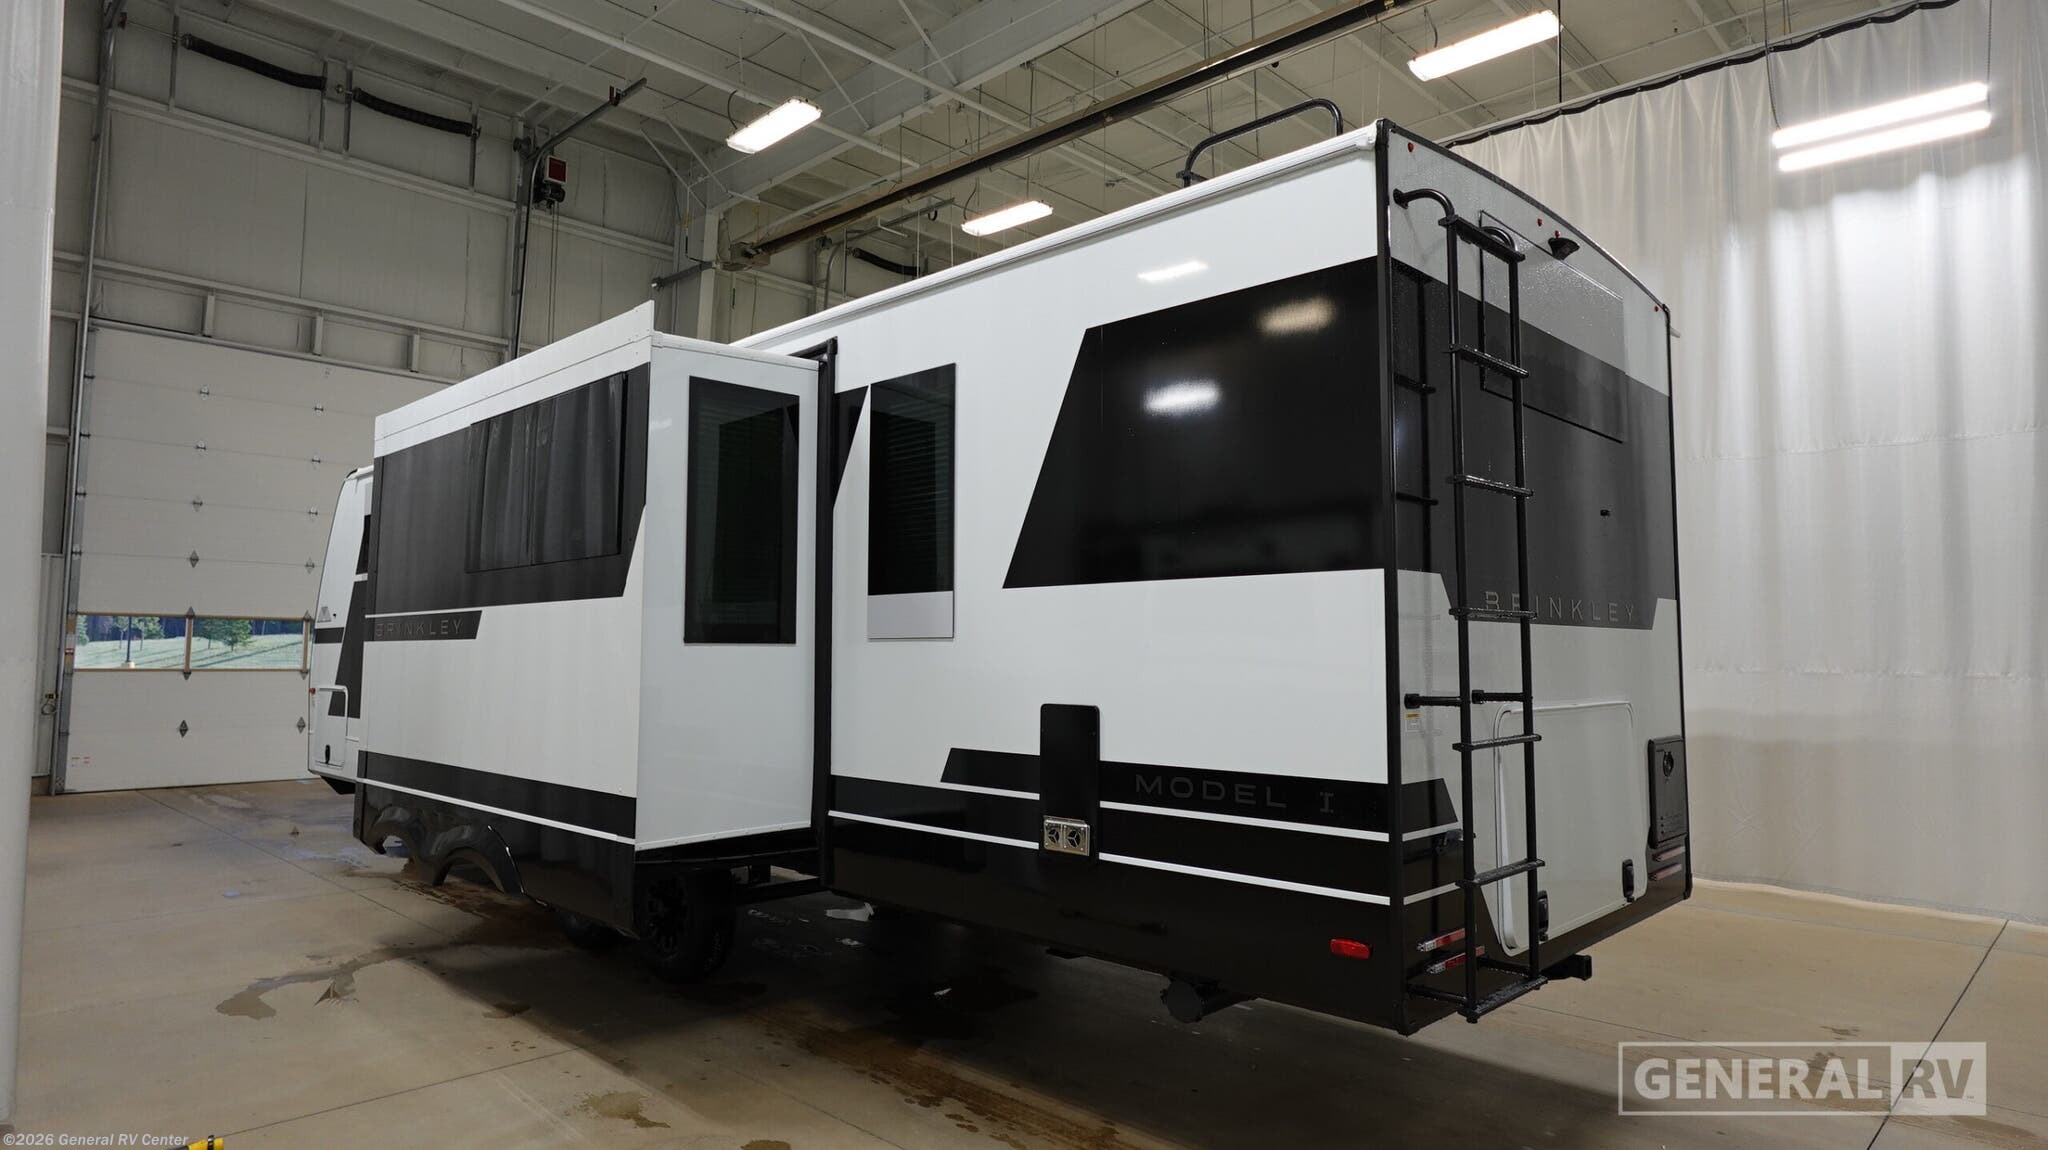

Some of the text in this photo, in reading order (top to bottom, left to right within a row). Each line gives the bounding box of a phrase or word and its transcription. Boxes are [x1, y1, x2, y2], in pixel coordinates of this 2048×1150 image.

[375, 619, 463, 637] BRINKLEY
[1135, 774, 1334, 813] MODEL I
